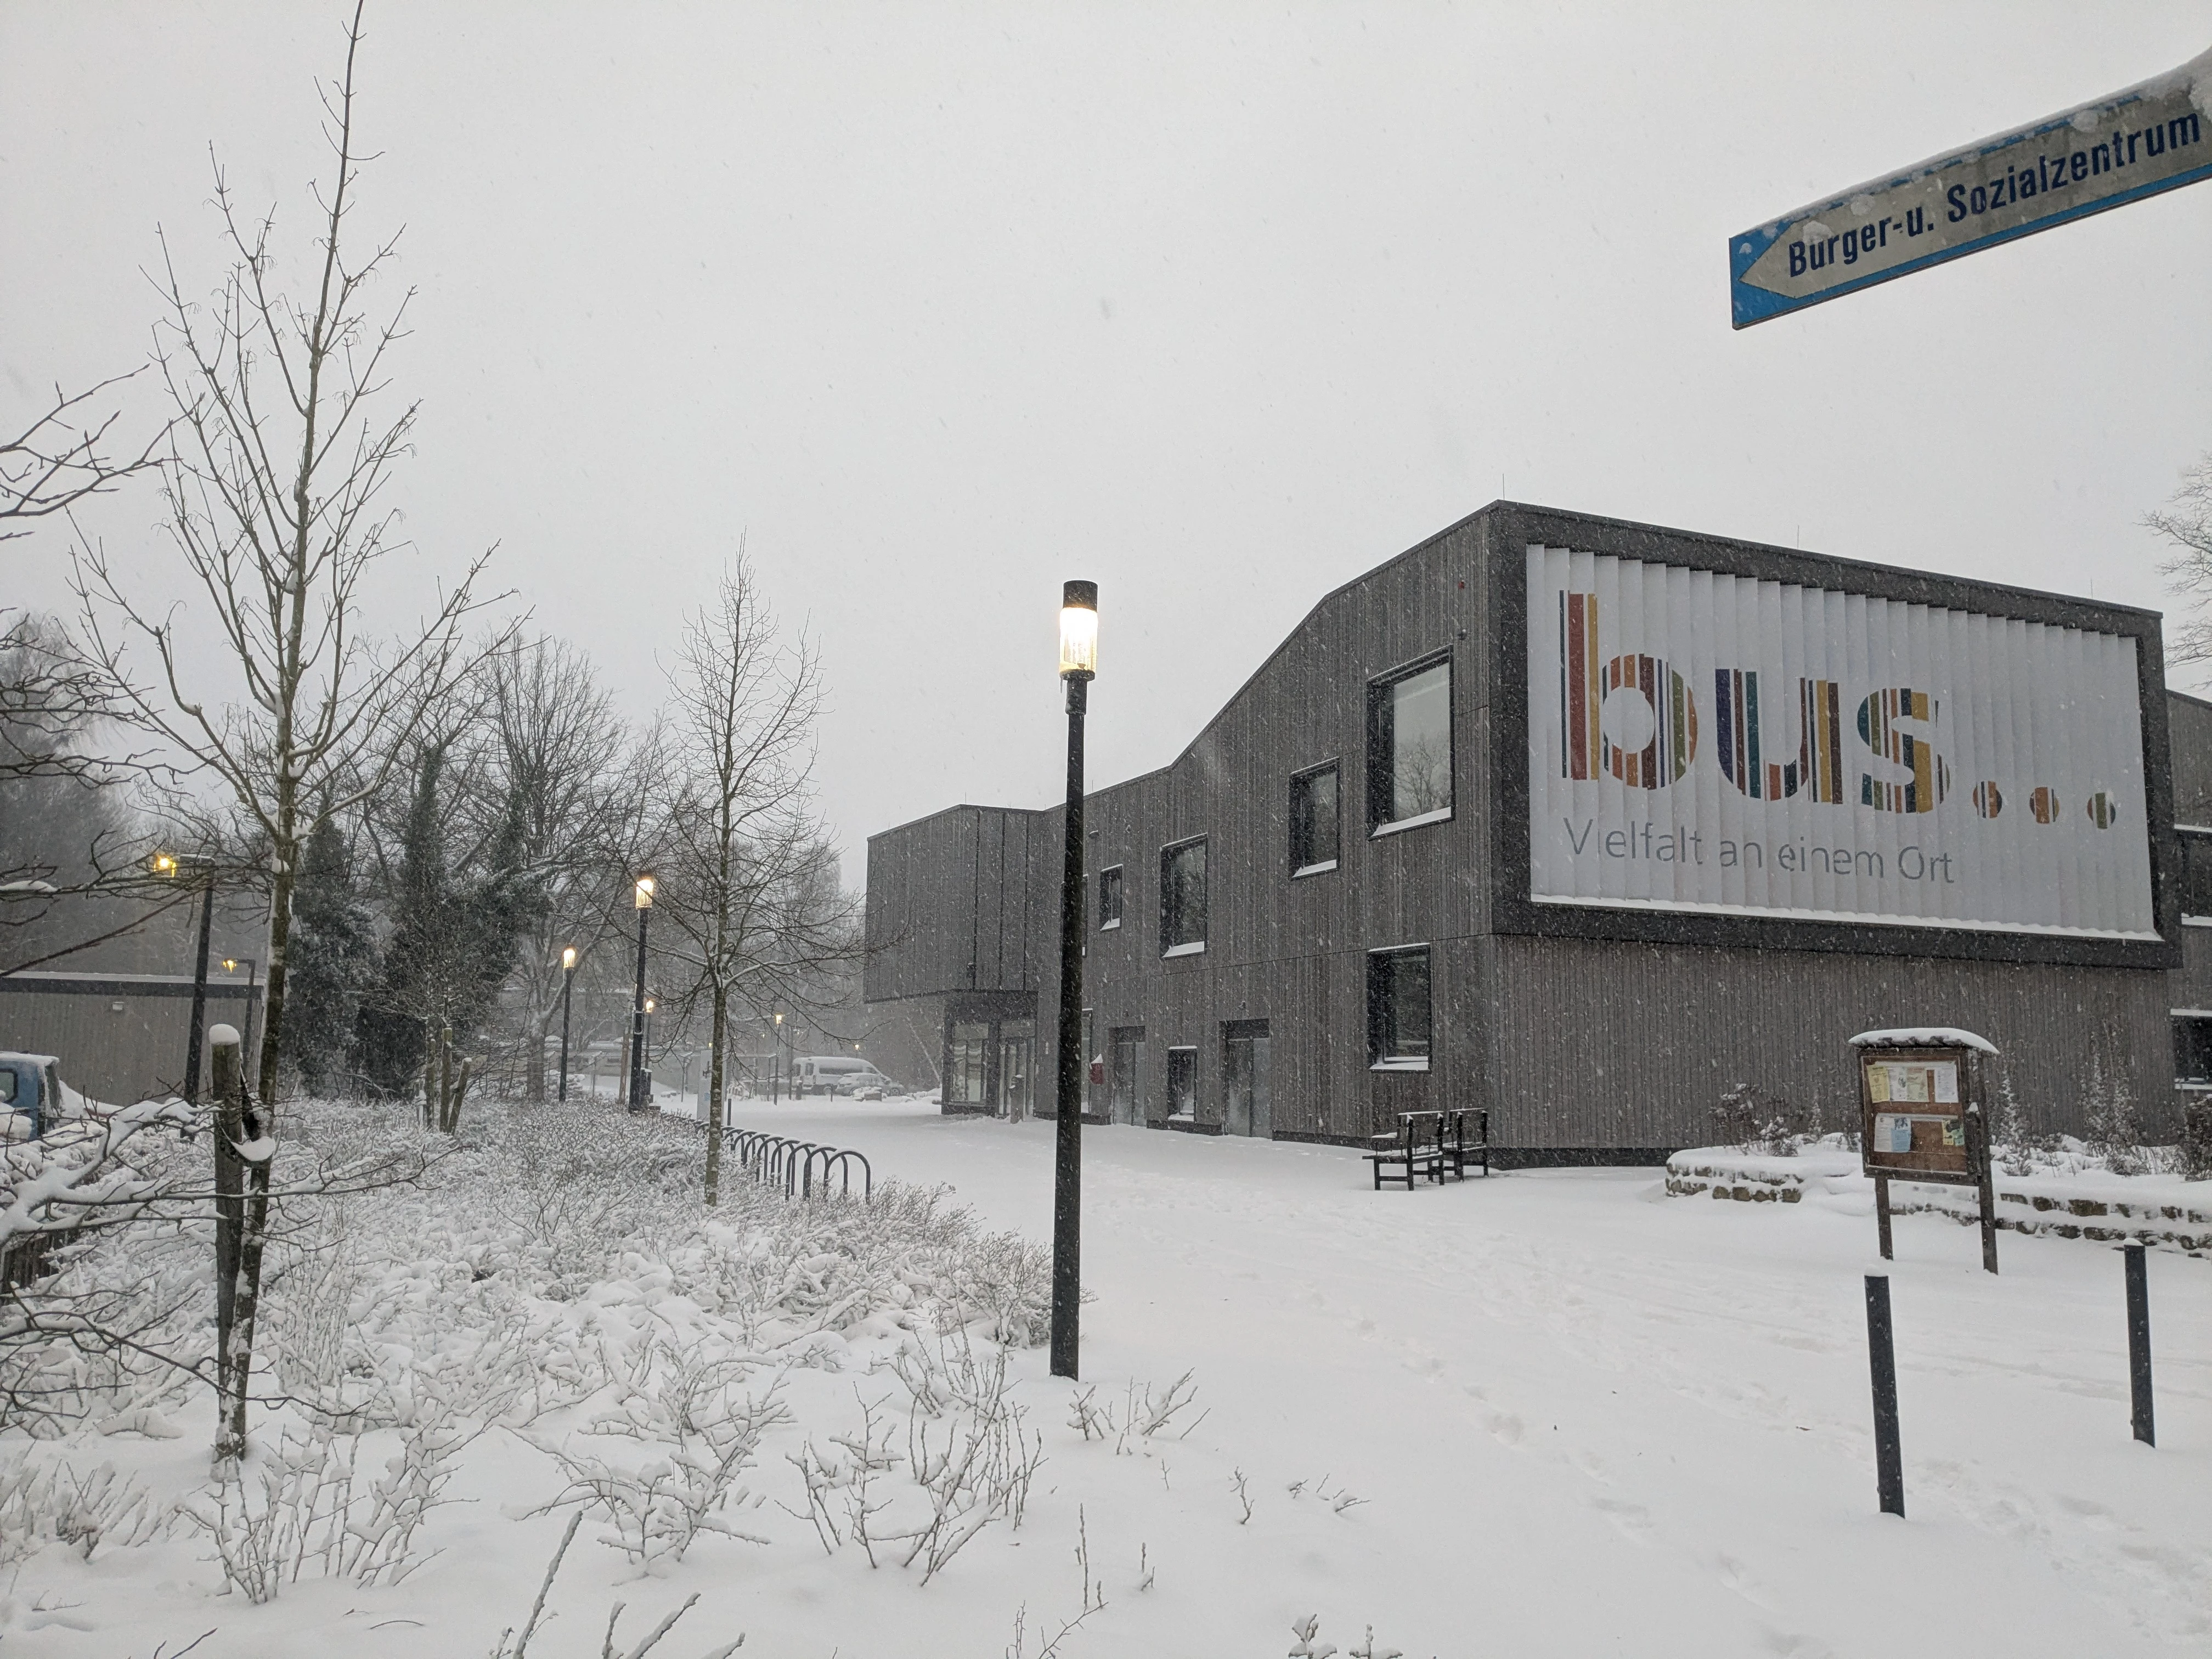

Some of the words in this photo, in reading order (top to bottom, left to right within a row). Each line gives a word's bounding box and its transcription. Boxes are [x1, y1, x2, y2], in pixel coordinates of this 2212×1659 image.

[1947, 112, 2200, 223] Sozialzentrum
[1563, 817, 1703, 865] Vielfalt
[1719, 839, 1763, 868] an
[1778, 836, 1884, 878] einem
[1898, 845, 1955, 883] Ort
